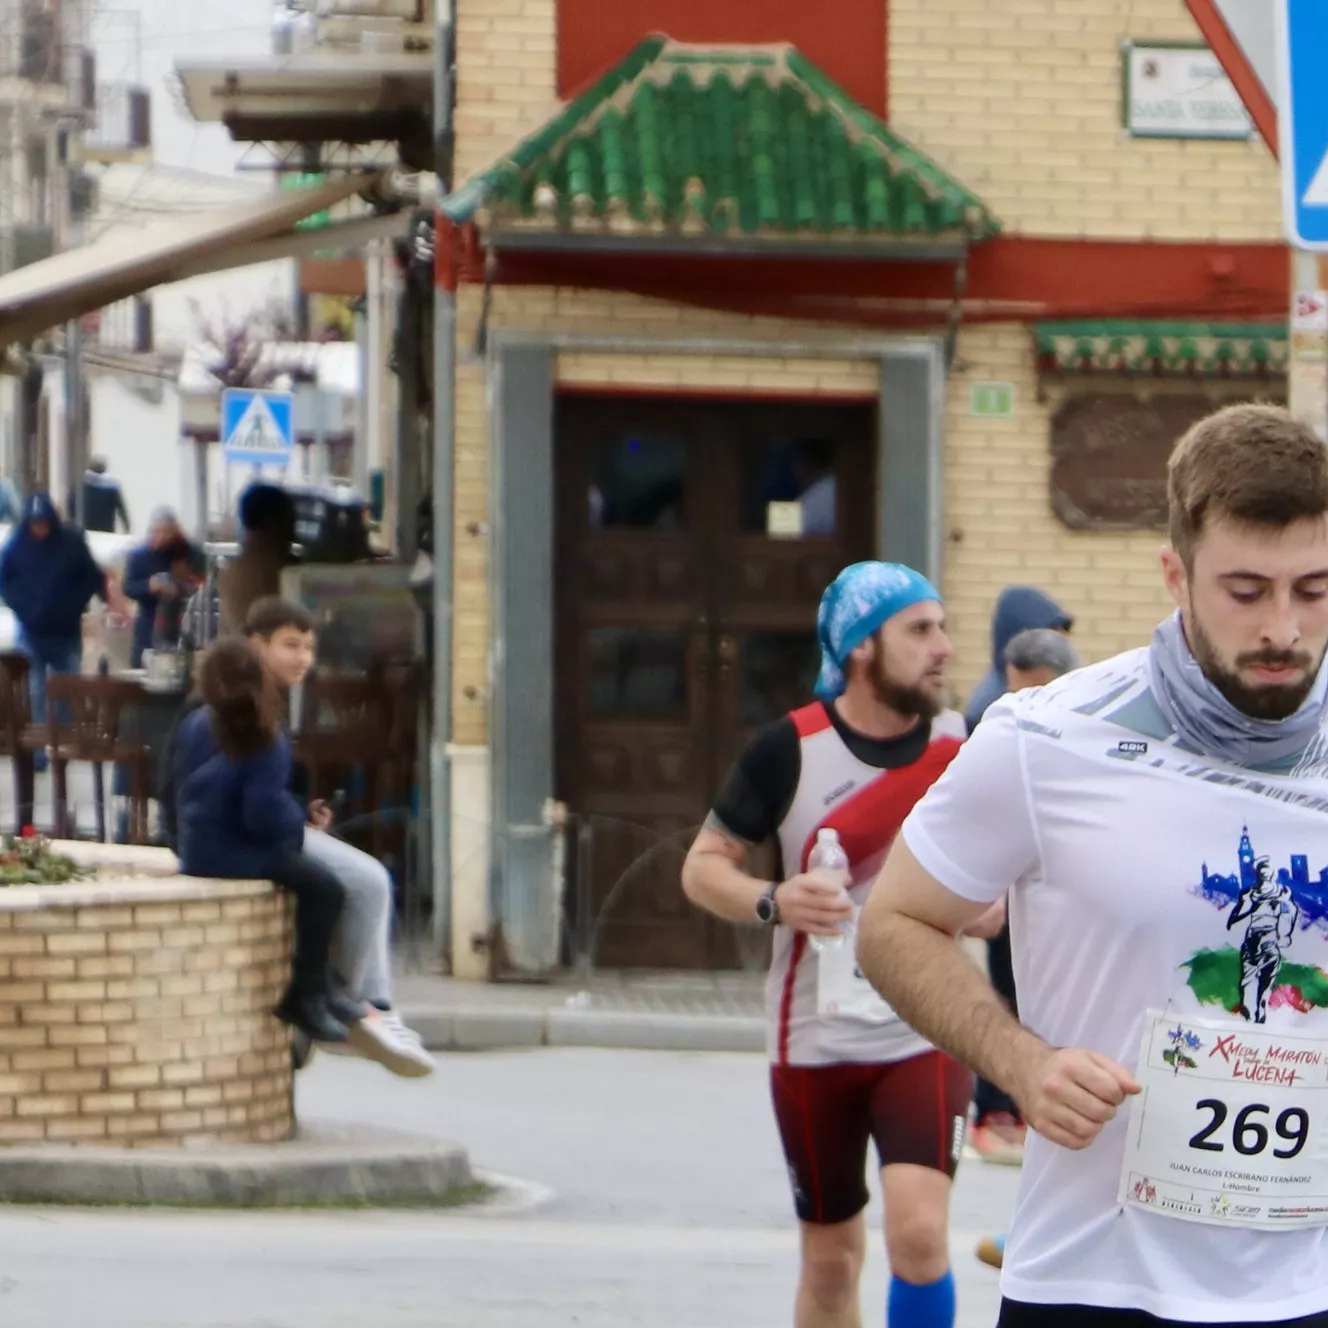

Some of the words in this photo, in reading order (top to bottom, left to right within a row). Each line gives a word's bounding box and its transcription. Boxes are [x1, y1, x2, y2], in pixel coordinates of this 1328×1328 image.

[1232, 1059, 1302, 1087] LUCENA
[1188, 1098, 1310, 1159] 269
[1192, 1167, 1222, 1178] CARLOS
[1224, 1170, 1269, 1183] ESCRIBANO
